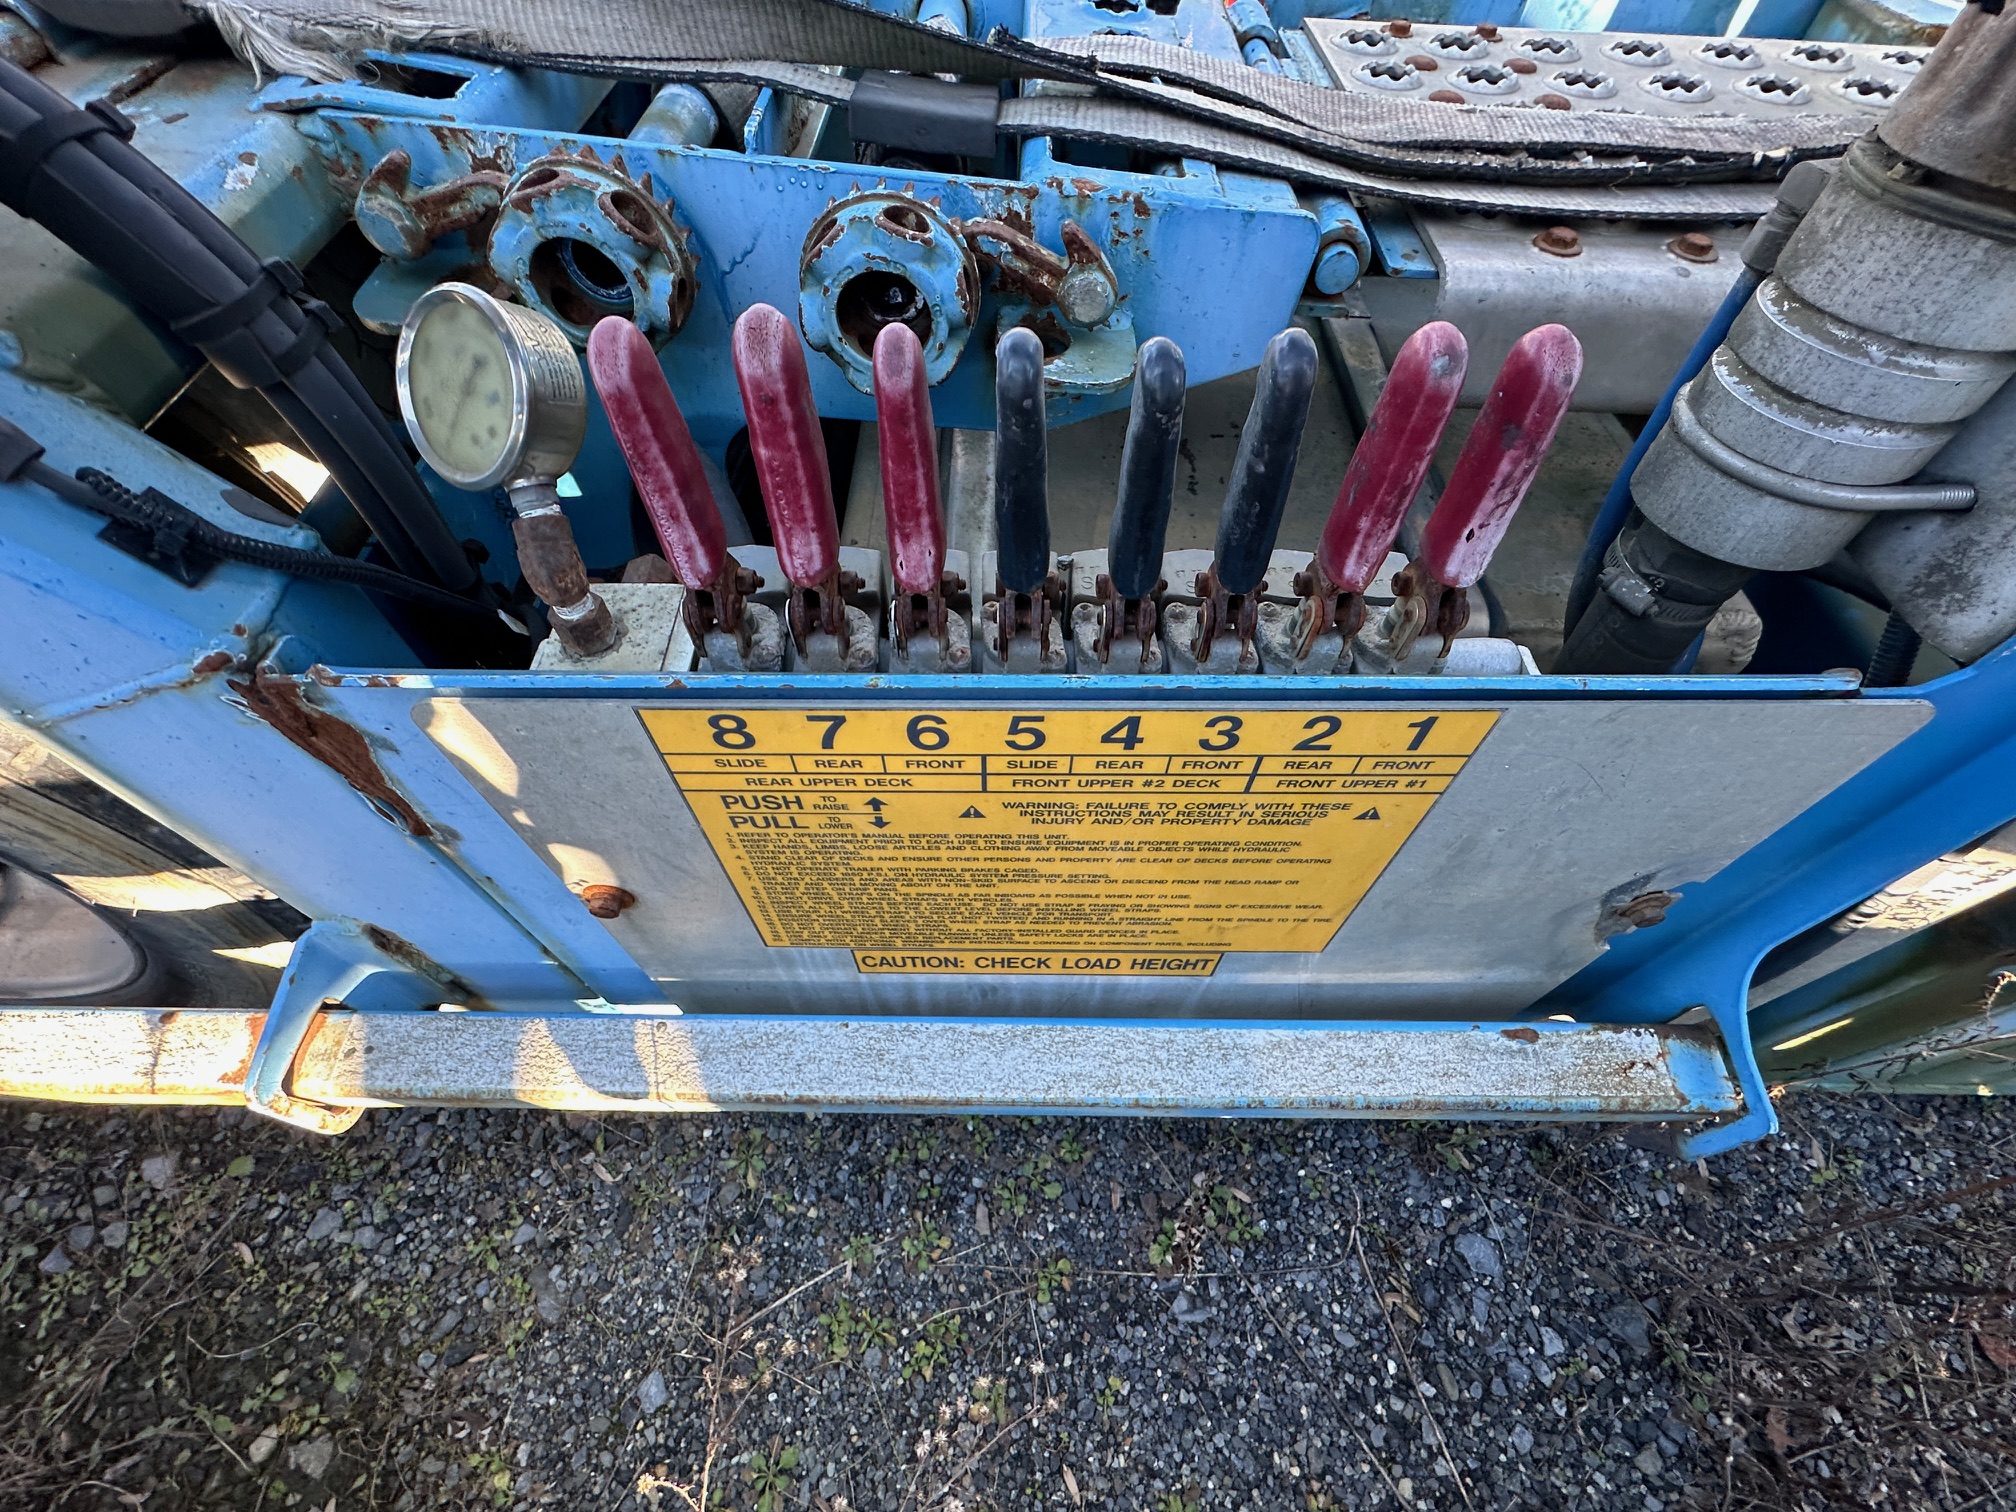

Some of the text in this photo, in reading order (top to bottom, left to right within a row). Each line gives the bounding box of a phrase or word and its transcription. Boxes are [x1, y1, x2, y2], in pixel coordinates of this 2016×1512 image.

[707, 713, 1440, 752] 8 7 6 5 4 3 2 1
[713, 758, 768, 768] SLIDE
[813, 759, 864, 769] REAR
[905, 759, 966, 769] FRONT
[1006, 760, 1058, 769] SLIDE
[1095, 760, 1144, 770] REAR
[1181, 760, 1244, 770] FRONT
[1283, 760, 1333, 770] REAR
[1371, 760, 1436, 770] FRONT
[744, 777, 913, 787] REAR UPPER DECK
[1012, 778, 1222, 788] FRONT UPPER #2 DECK
[1275, 779, 1428, 789] FRONT UPPER #1
[719, 795, 805, 810] PUSH
[819, 795, 838, 803] TO
[812, 803, 850, 811] RAISE
[1001, 802, 1353, 811] WARNING: FAILURE TO COMPLY WITH THESE
[825, 814, 842, 822] TO
[1019, 809, 1329, 819] INSTRUCTIONS MAY RESULT IN SERIOUS
[728, 814, 810, 829] PULL
[817, 821, 854, 830] LOWER
[1031, 817, 1313, 826] INJURY AND/OR PROPERTY DAMAGE
[861, 955, 1215, 971] CAUTION: CHECK LOAD HEIGHT
